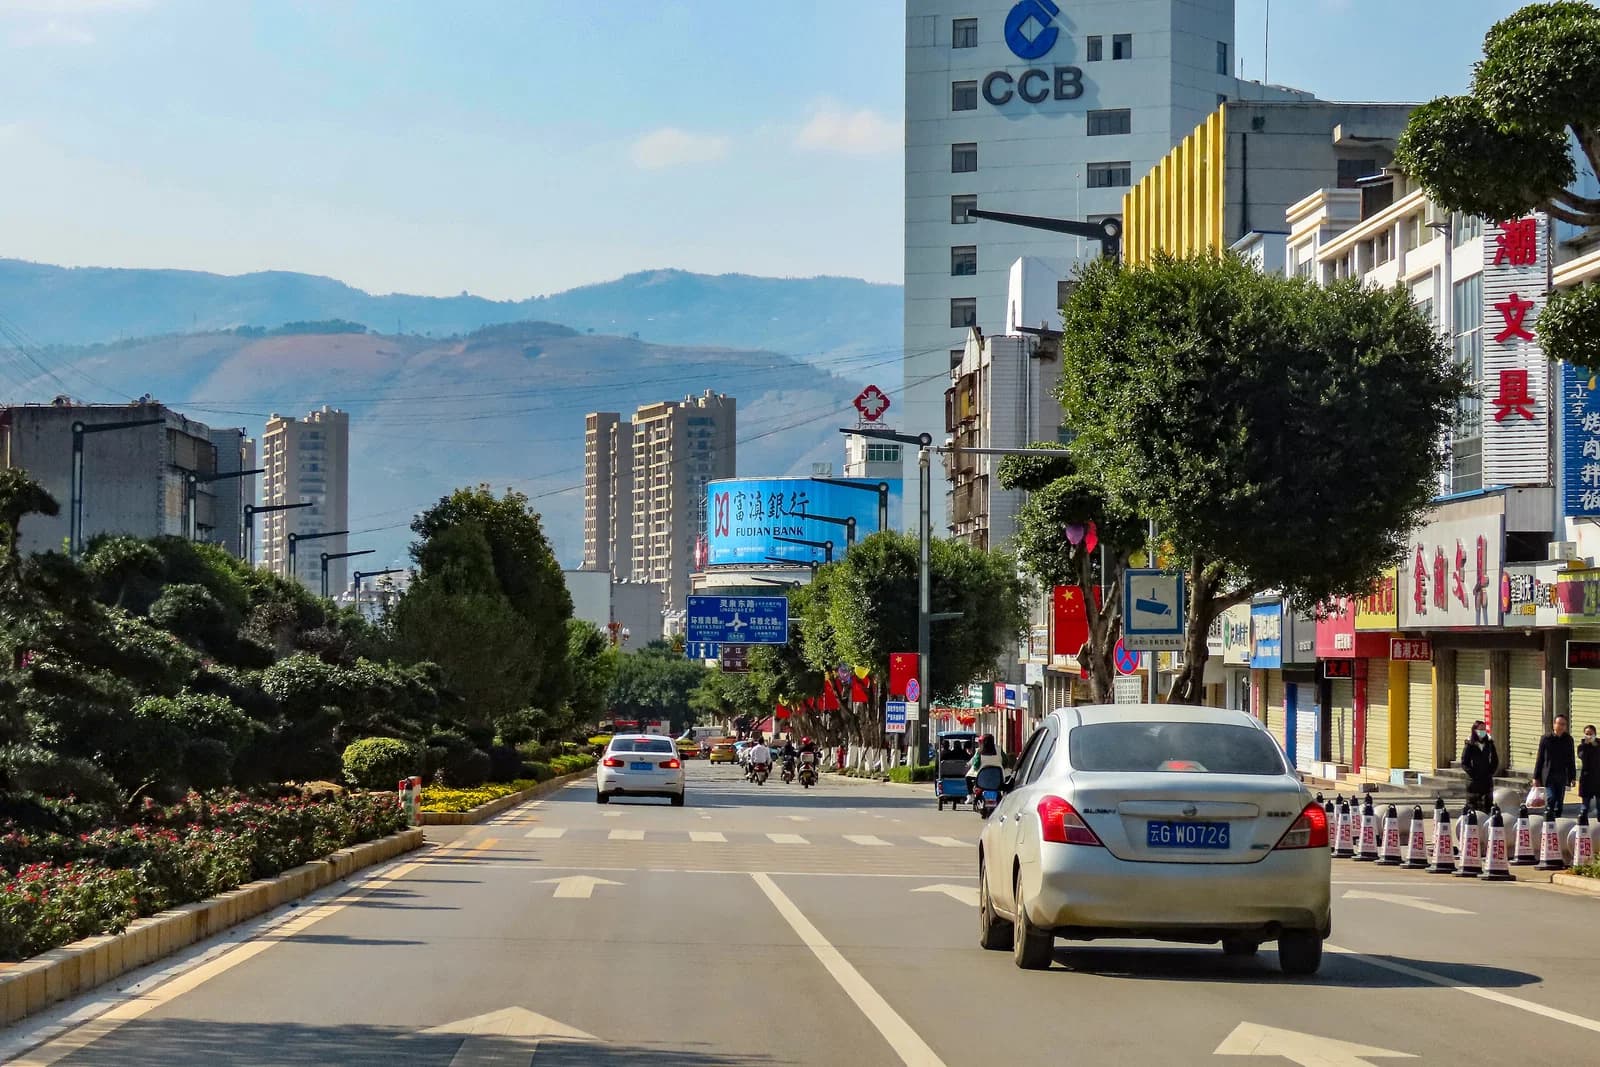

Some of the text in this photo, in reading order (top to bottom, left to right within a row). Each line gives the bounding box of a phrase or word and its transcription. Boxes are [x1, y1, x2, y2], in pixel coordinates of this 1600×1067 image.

[982, 66, 1084, 106] CCB
[736, 526, 804, 537] FUDIAN BANK
[1175, 825, 1228, 844] W0726
